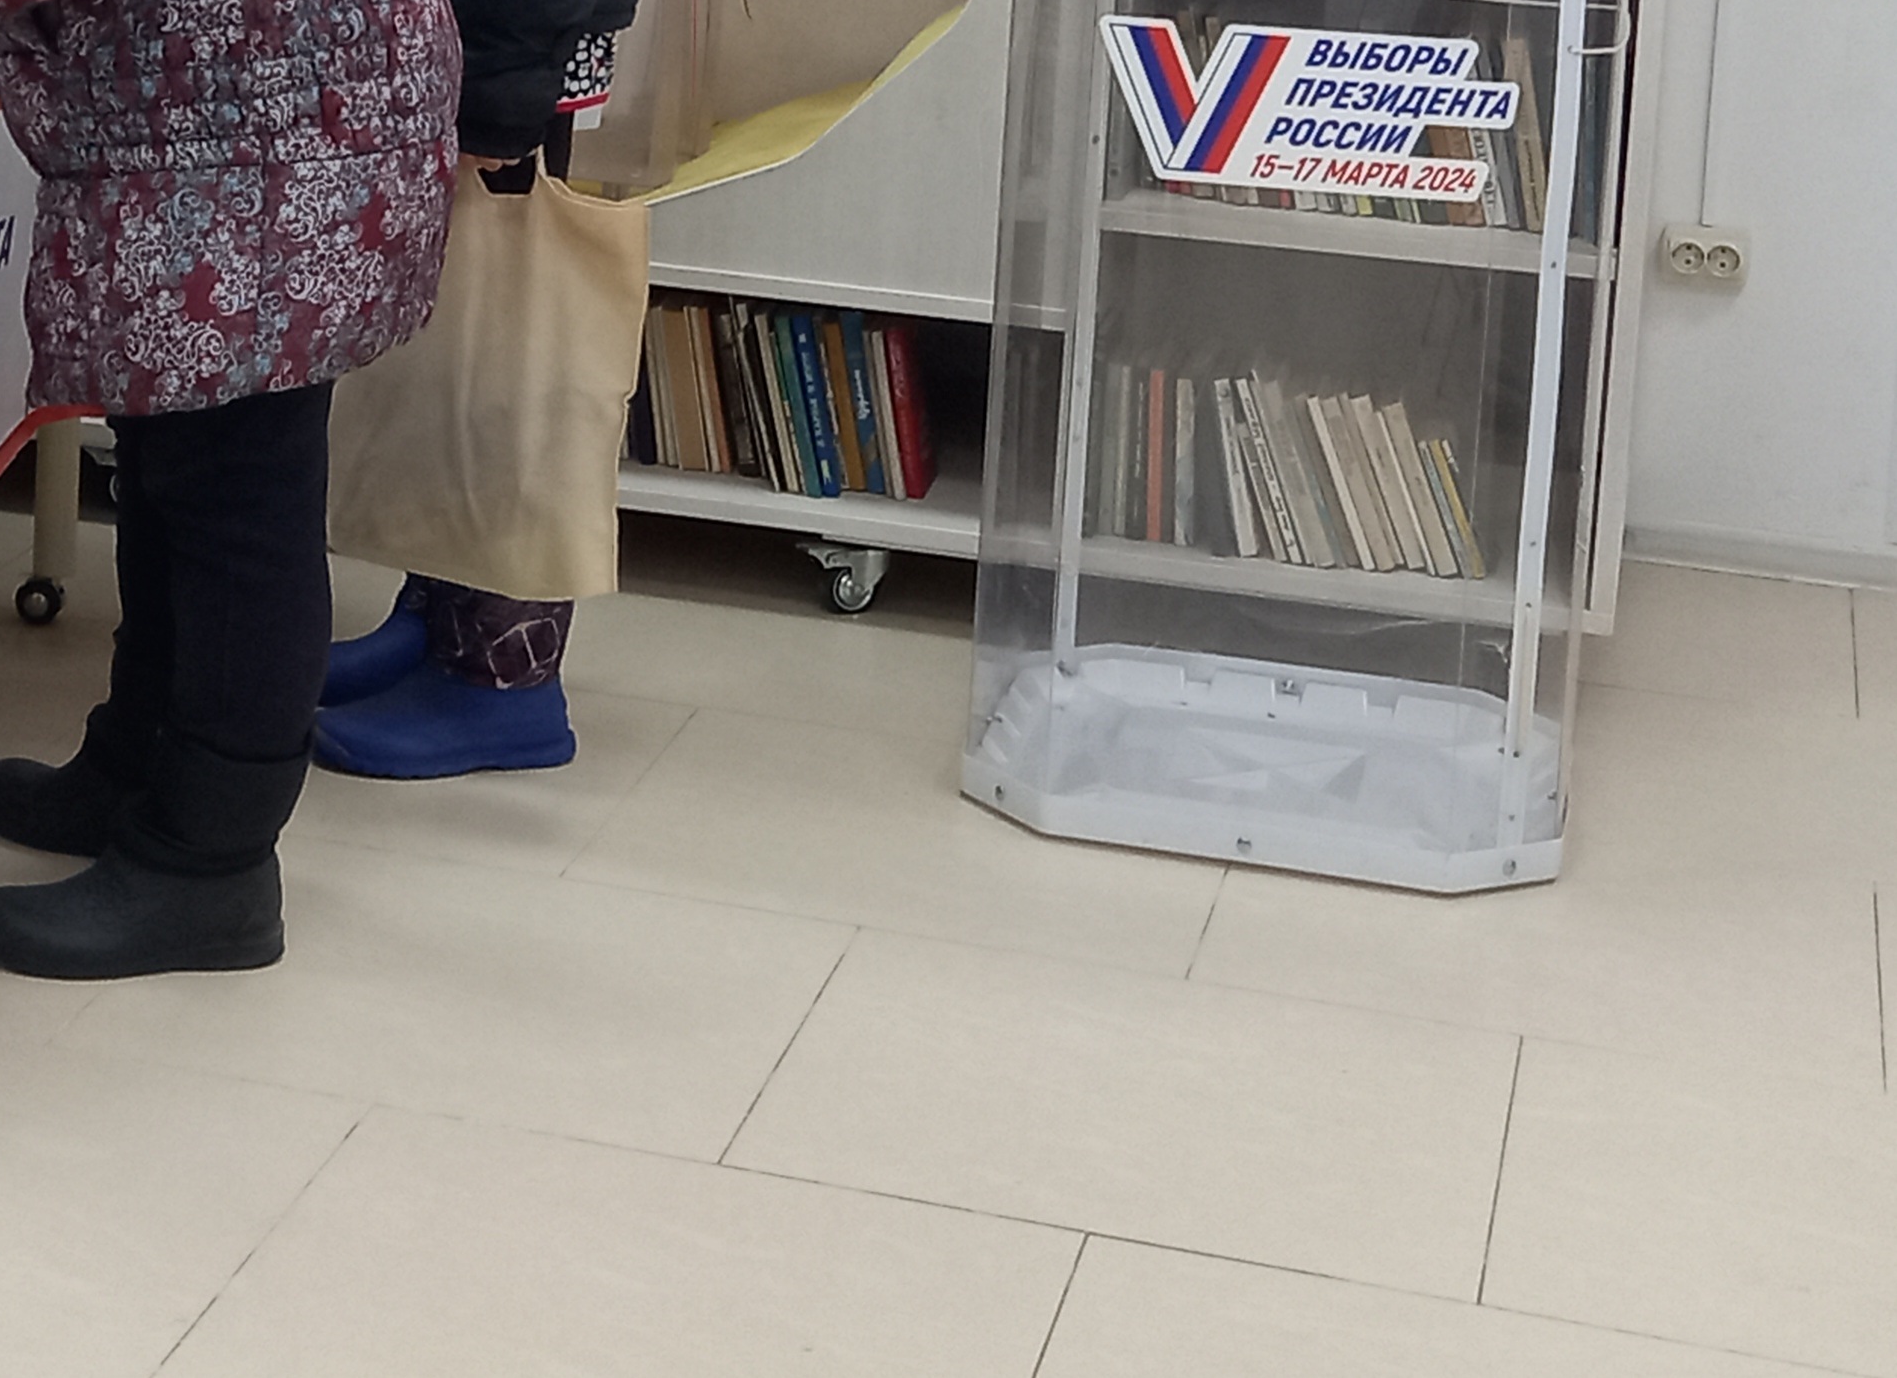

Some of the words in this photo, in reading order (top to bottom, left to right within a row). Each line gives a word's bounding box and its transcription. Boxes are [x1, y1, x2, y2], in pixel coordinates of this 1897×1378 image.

[1304, 39, 1470, 77] ВЫБОРЫ
[1283, 77, 1513, 120] ПРЕЗИДЕНТА
[1263, 116, 1413, 155] РОССИИ
[1320, 158, 1411, 190] МАРТА
[1411, 165, 1478, 195] 2024
